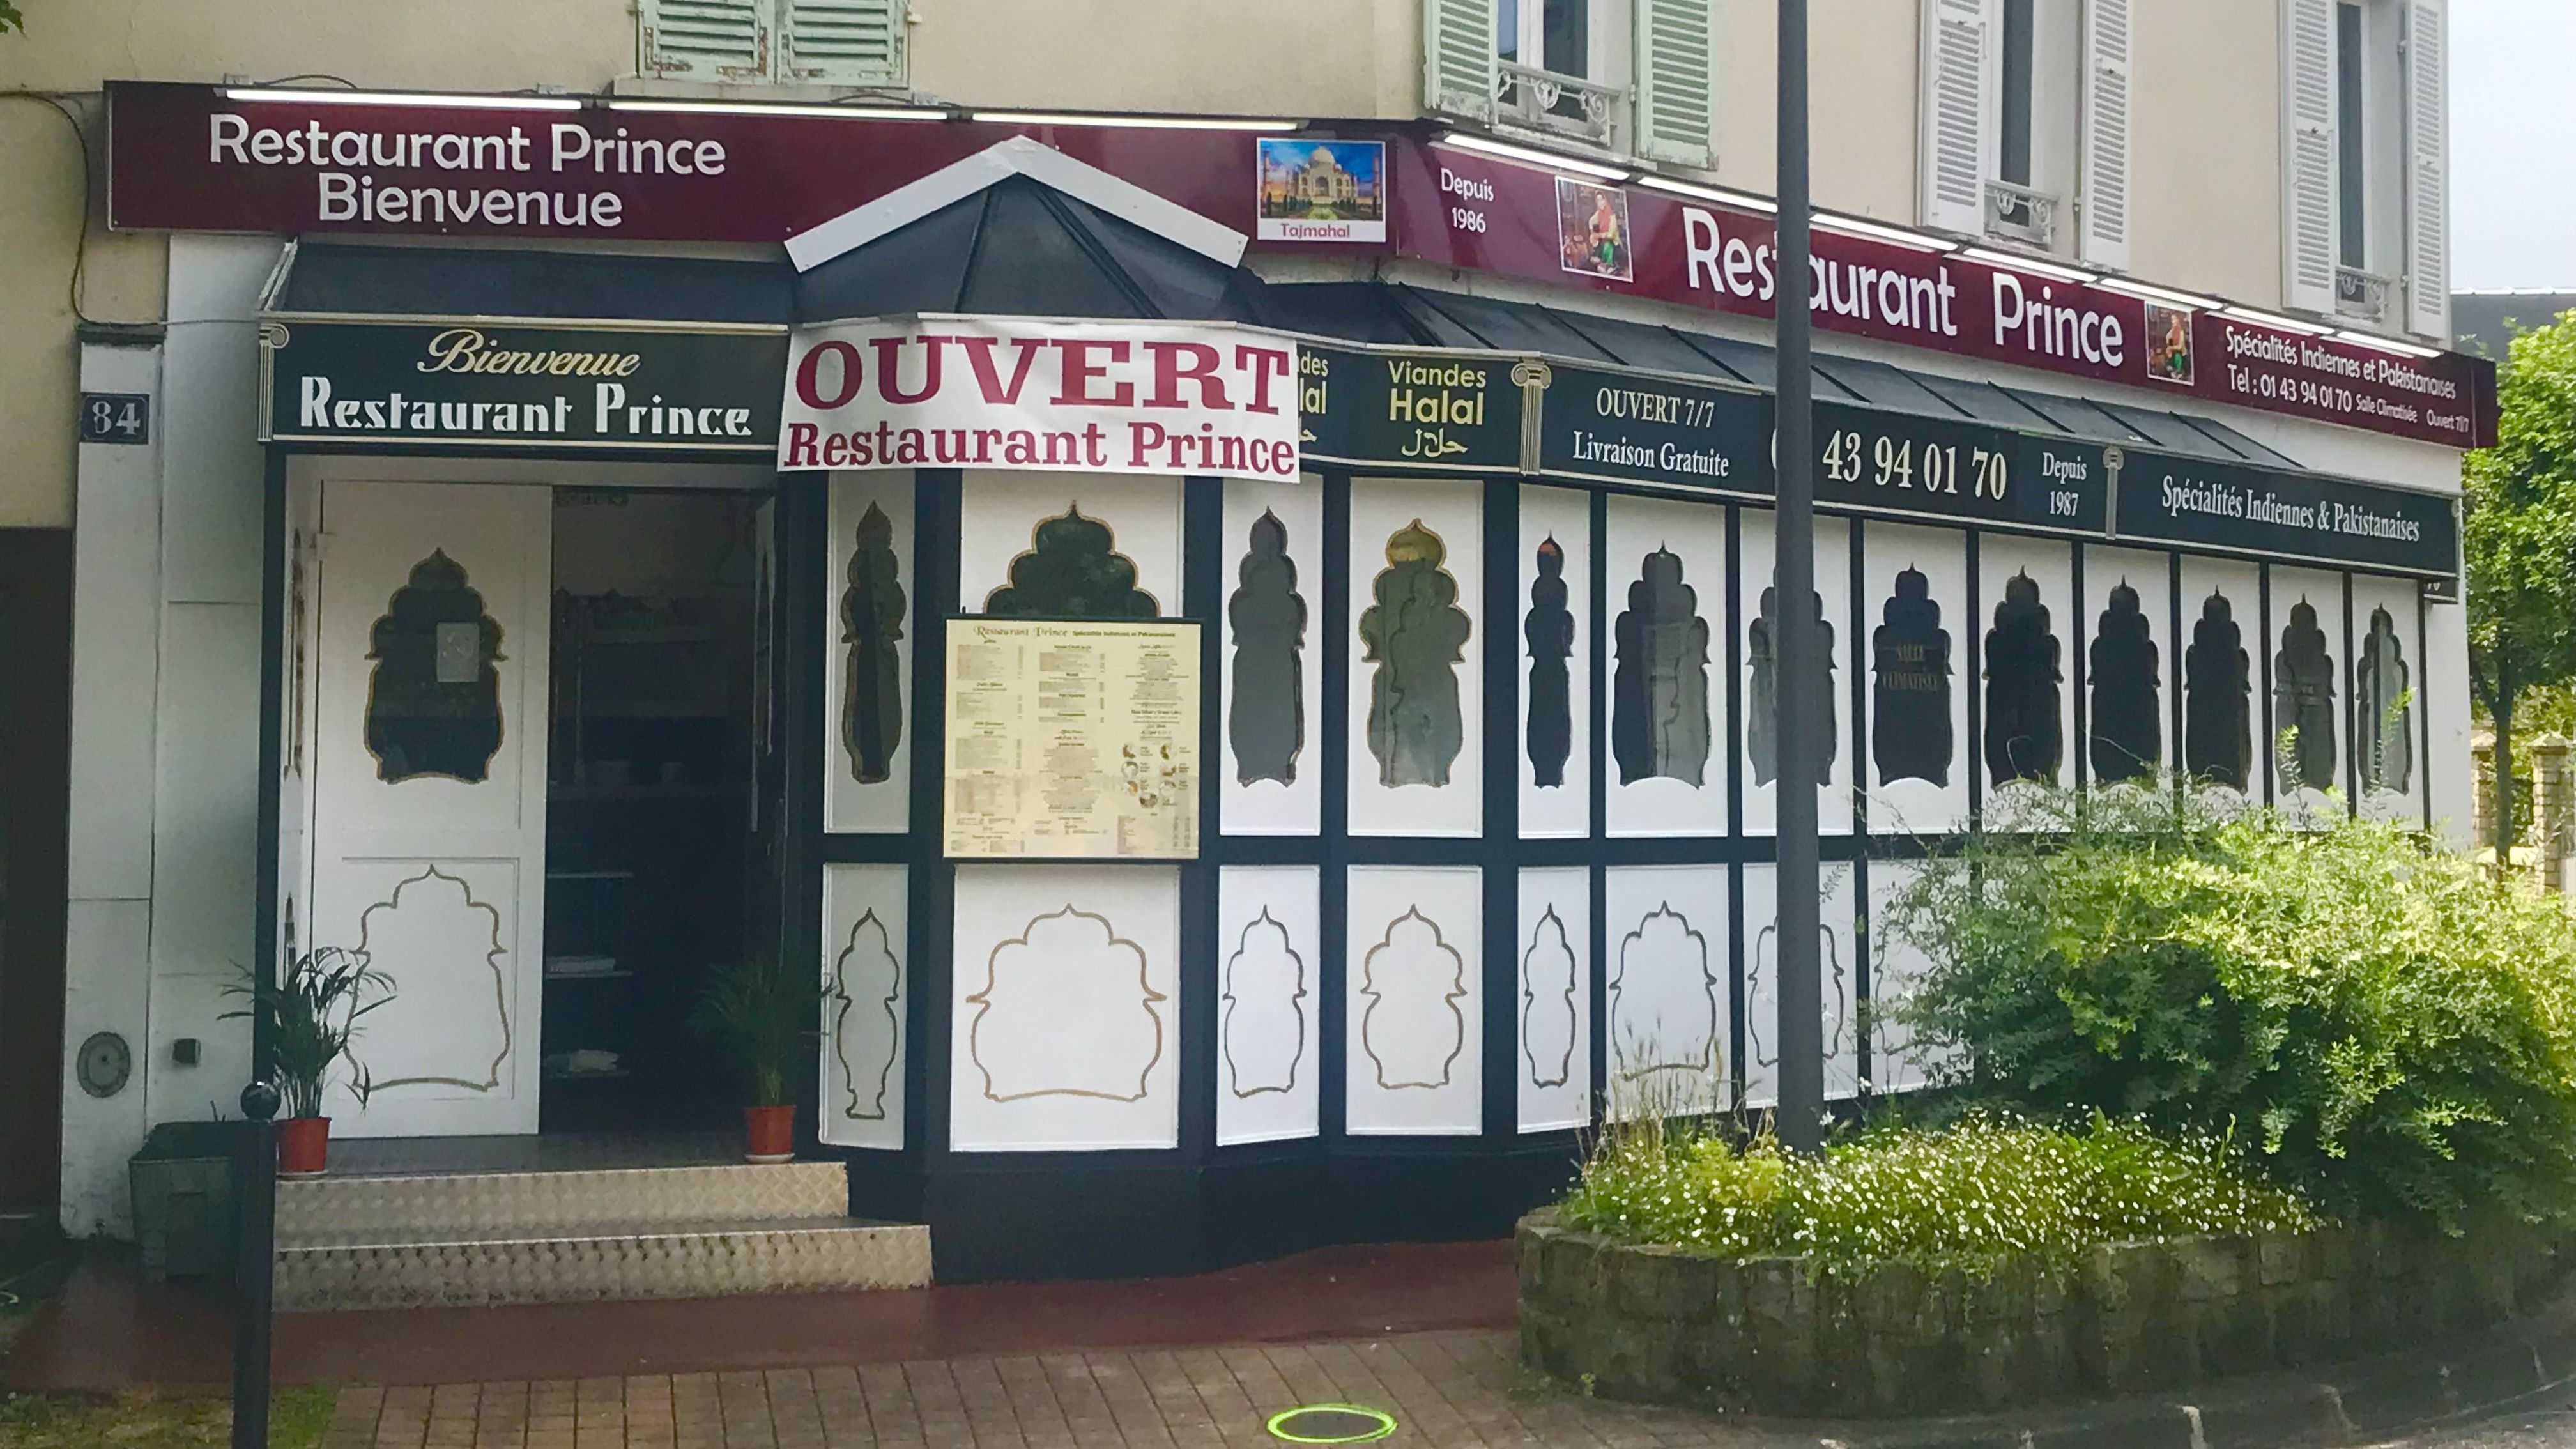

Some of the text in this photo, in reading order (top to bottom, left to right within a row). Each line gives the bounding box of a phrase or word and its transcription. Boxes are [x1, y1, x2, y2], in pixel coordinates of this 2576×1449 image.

[210, 114, 726, 176] Restaurant Prince
[319, 173, 623, 227] Bienvenue
[1440, 167, 1494, 203] Depuis
[1280, 222, 1351, 241] Tajmahal
[1451, 206, 1487, 234] 1986
[1682, 206, 2124, 367] Resaurant Prince
[417, 328, 640, 377] Bienvenue
[795, 336, 1291, 415] OUVERT
[1388, 360, 1487, 388] Viandes
[2225, 326, 2456, 399] Spécialités Indiennes et Pakistanaises
[301, 376, 753, 436] Restaurant Prince
[1299, 378, 1326, 414] lal
[1390, 388, 1483, 425] Halal
[1596, 387, 1715, 428] OUVERT 7/7
[2228, 364, 2250, 394] Tel
[2260, 374, 2276, 398] 01
[2280, 378, 2297, 401] 43
[2301, 381, 2317, 405] 94
[2320, 386, 2333, 409] 01
[2336, 389, 2352, 412] 70
[91, 401, 142, 435] 84
[785, 420, 1108, 469] Restaurant
[1127, 422, 1296, 475] Prince
[1401, 428, 1468, 457] حلال
[1573, 431, 1655, 471] Livraison
[1660, 441, 1729, 478] Gratuite
[1823, 429, 1862, 482] 43
[1875, 436, 1912, 488] 94
[1924, 443, 1958, 494] 01
[1972, 445, 2007, 501] 70
[2043, 451, 2087, 486] Depuis
[2050, 490, 2078, 517] 1987
[2162, 475, 2419, 542] Spécialités Indiennes & Pakistanaises
